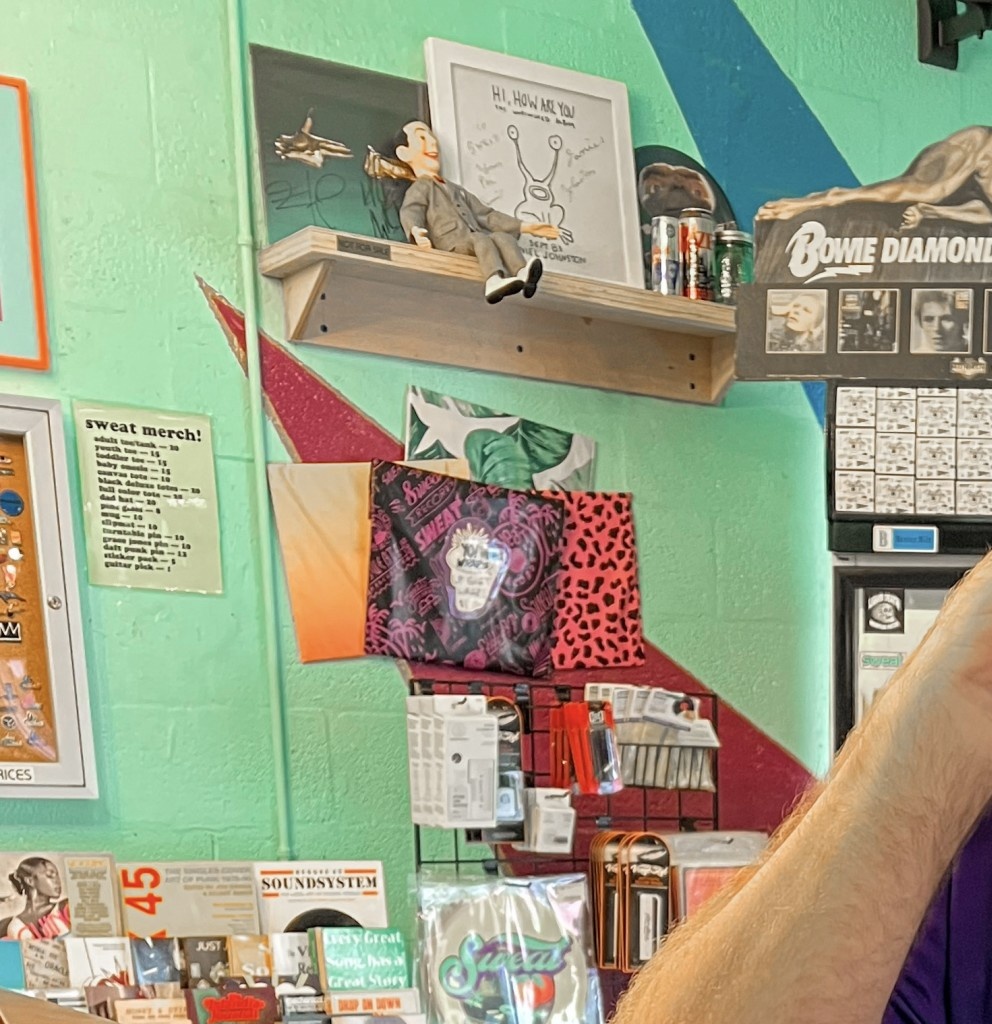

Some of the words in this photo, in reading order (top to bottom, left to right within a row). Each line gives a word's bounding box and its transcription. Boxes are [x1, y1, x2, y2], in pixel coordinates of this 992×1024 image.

[557, 101, 575, 118] YOU
[785, 220, 878, 278] BOWIE
[85, 419, 137, 435] sweat
[142, 426, 202, 442] merch!
[414, 496, 463, 552] SWEAT
[261, 875, 378, 891] SOUNDSYSTEM
[196, 941, 221, 951] JUST
[368, 972, 408, 989] Story
